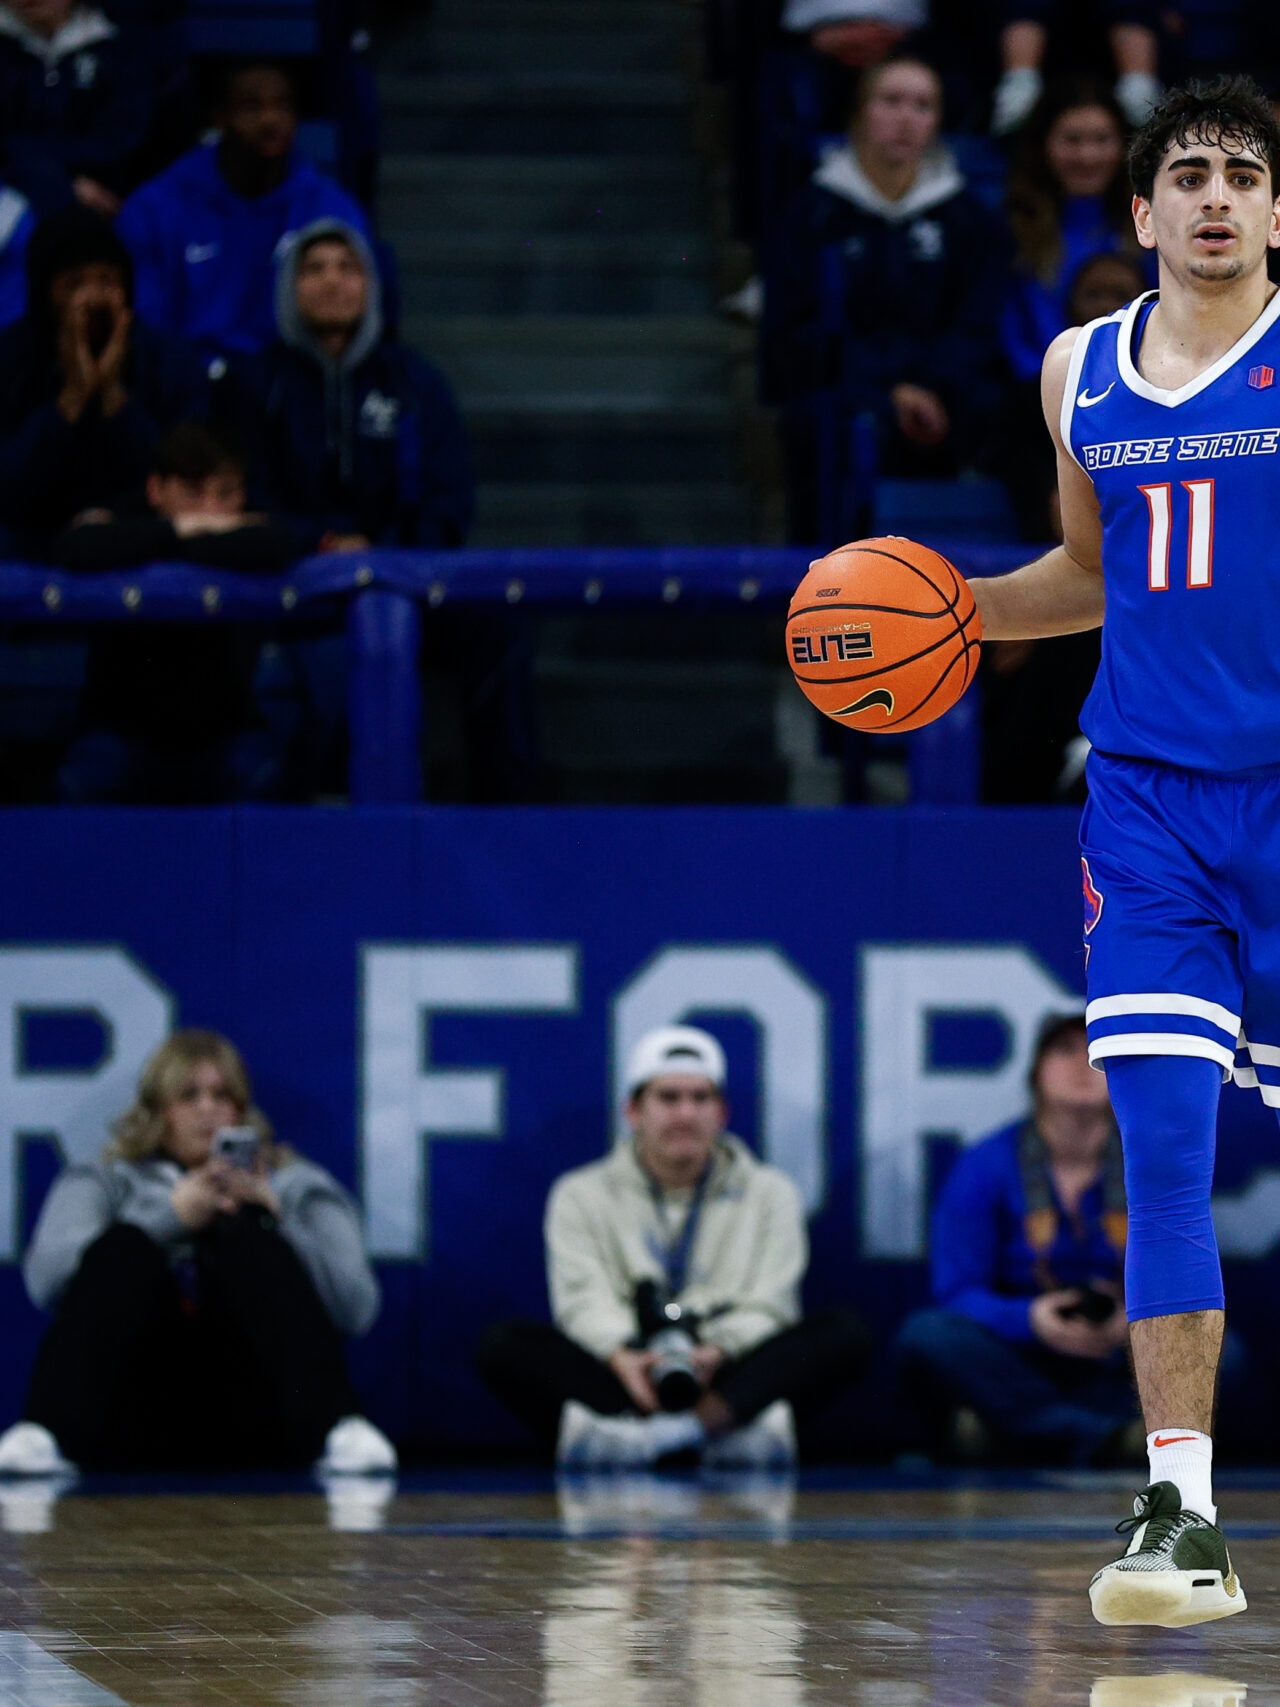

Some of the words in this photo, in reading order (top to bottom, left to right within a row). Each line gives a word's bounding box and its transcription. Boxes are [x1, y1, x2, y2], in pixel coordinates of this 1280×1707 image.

[1083, 437, 1174, 470] BOISE
[1178, 428, 1280, 461] STATE
[1136, 478, 1215, 591] 11
[792, 631, 874, 664] ELITE
